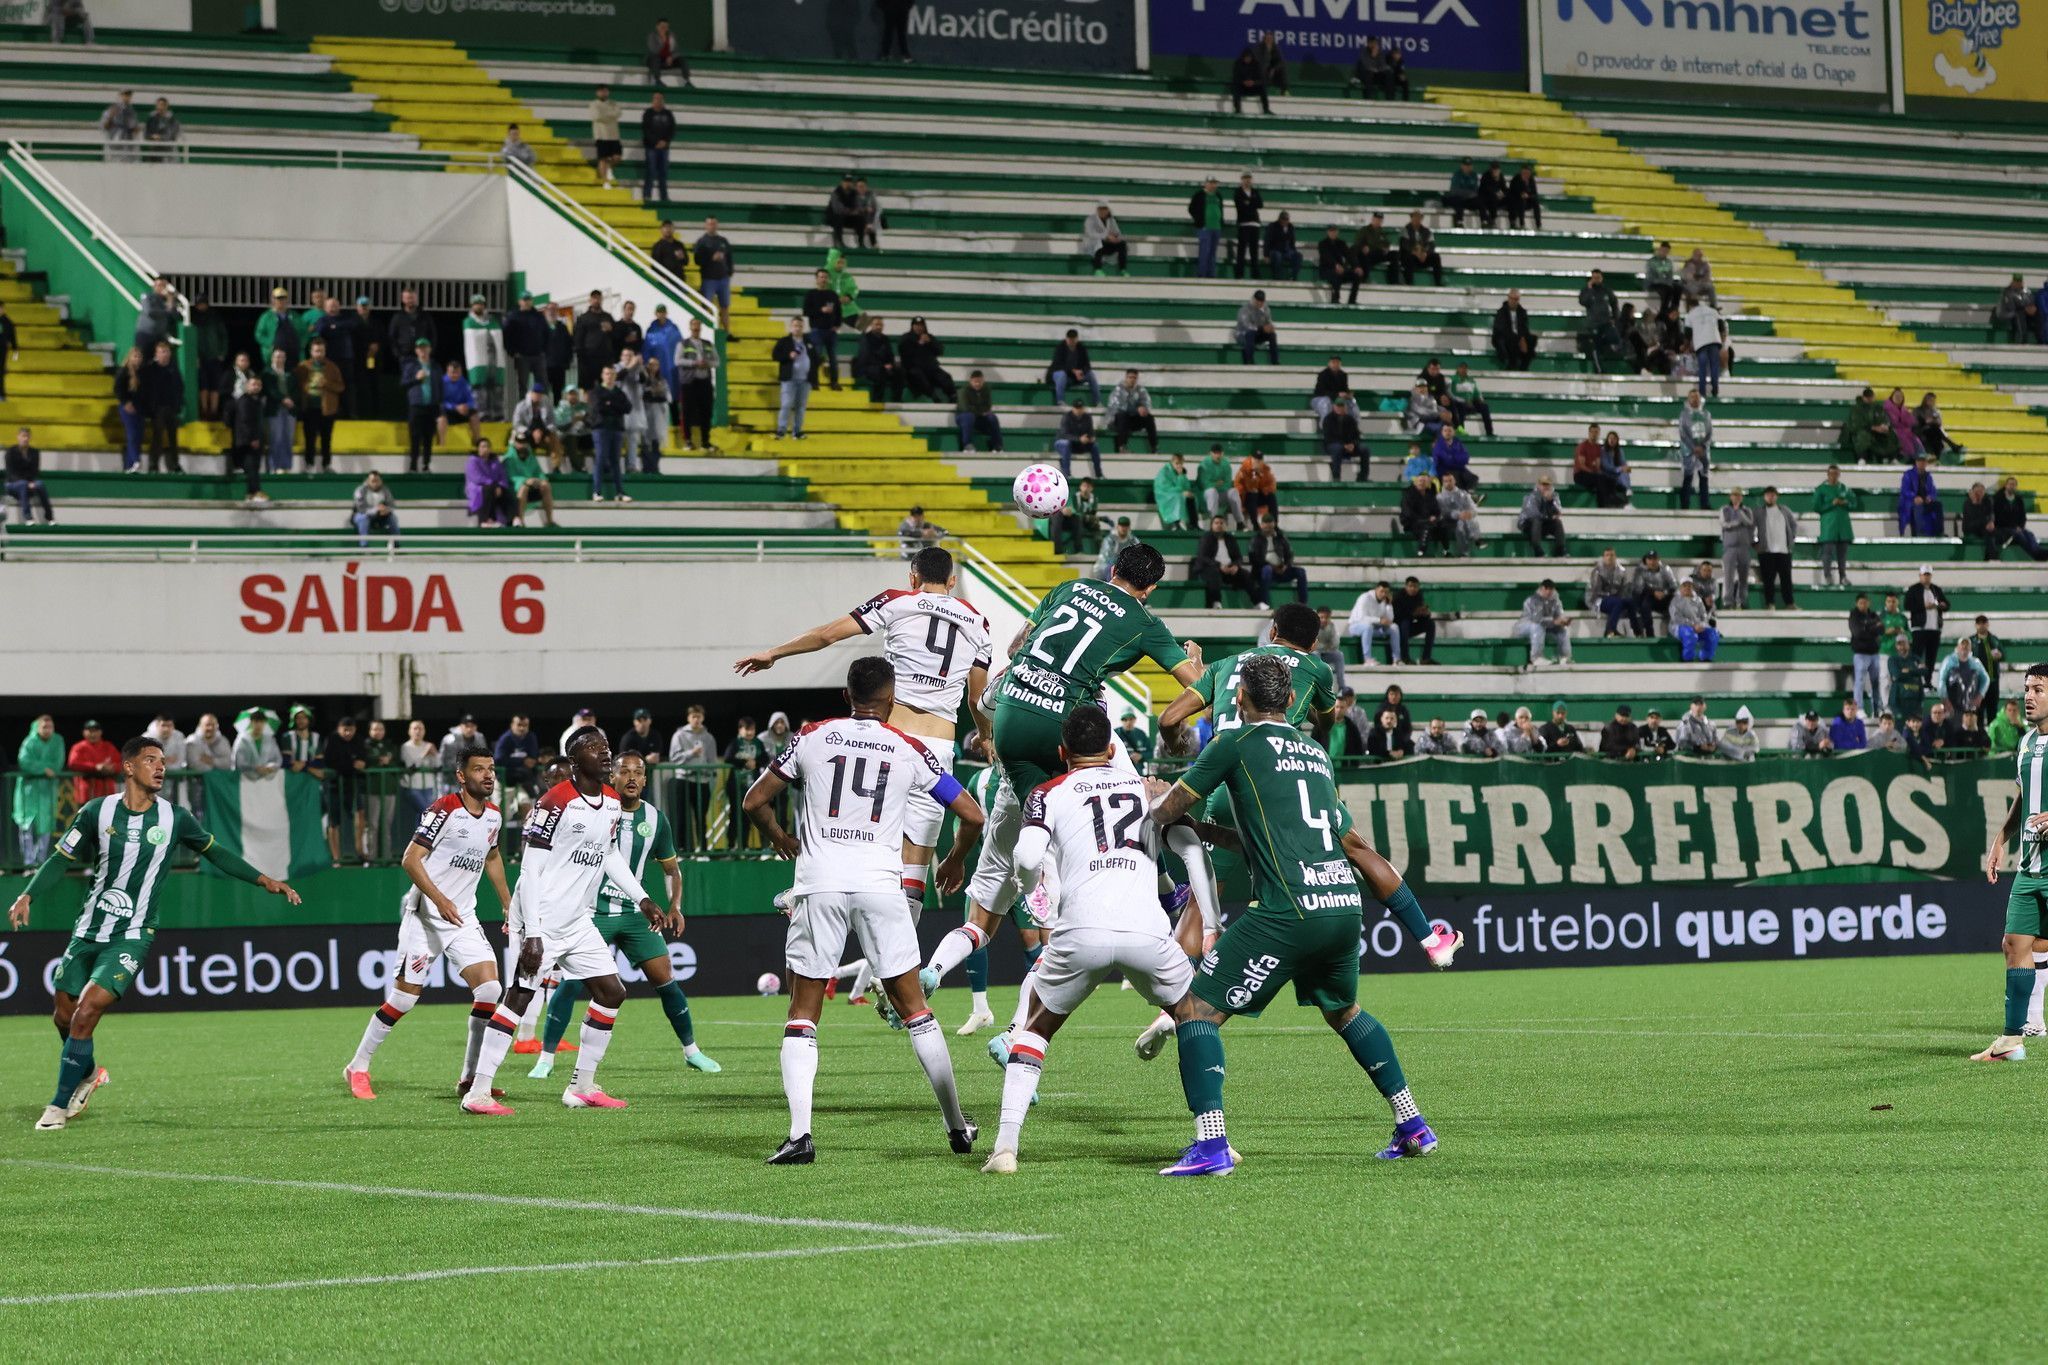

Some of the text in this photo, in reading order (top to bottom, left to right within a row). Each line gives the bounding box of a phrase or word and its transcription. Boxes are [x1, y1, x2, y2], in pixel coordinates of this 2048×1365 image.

[907, 6, 1108, 45] MaxiCrédito
[1664, 0, 1870, 40] mhnet
[1248, 28, 1430, 53] EMPREENDIMNTOS
[1806, 43, 1871, 56] TELECOM
[1577, 51, 1856, 87] O provedor de internet oficial da Chape
[240, 562, 546, 635] SAÍDA 6
[934, 605, 975, 625] ADEMICON
[1070, 595, 1107, 621] KAUAN
[1081, 584, 1127, 619] SICOOB
[925, 615, 959, 678] 4
[1029, 603, 1103, 675] 27
[912, 673, 947, 689] ARTHUR
[1002, 682, 1066, 714] Unimed
[844, 739, 895, 753] ADEMICON
[1274, 756, 1306, 773] JOÃO
[826, 754, 892, 824] 14
[426, 809, 449, 841] HAVAN
[541, 806, 563, 840] HAVAN
[1083, 793, 1146, 853] 12
[1297, 779, 1334, 852] 4
[1339, 776, 1952, 886] UERREIROS
[1089, 858, 1137, 872] GILBERTO
[96, 899, 134, 919] Aurora
[600, 887, 632, 901] Auro
[1474, 895, 1948, 958] futebol que perde
[136, 939, 339, 997] utebol
[1242, 954, 1281, 992] alfa
